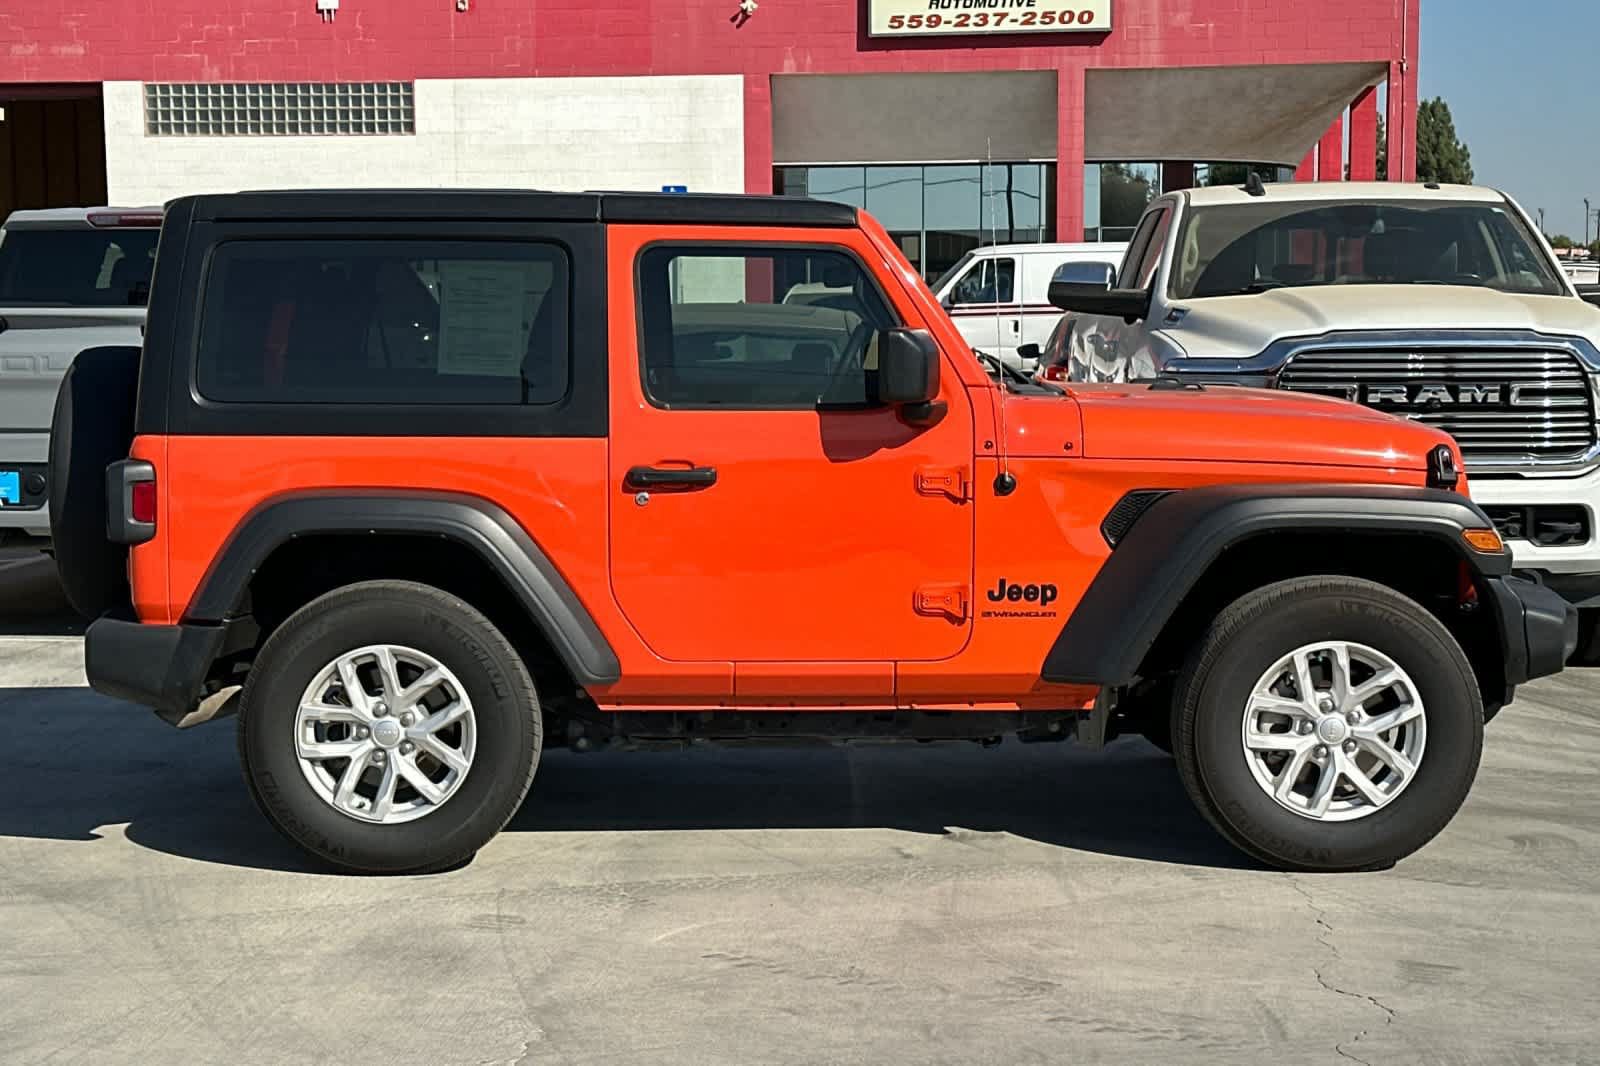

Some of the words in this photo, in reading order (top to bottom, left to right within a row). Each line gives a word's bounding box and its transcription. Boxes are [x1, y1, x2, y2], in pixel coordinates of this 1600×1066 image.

[928, 0, 1037, 9] AUTOMOTIVE
[888, 10, 1095, 29] 559-237-2500
[1367, 383, 1501, 404] RAM
[987, 578, 1058, 606] Jeep
